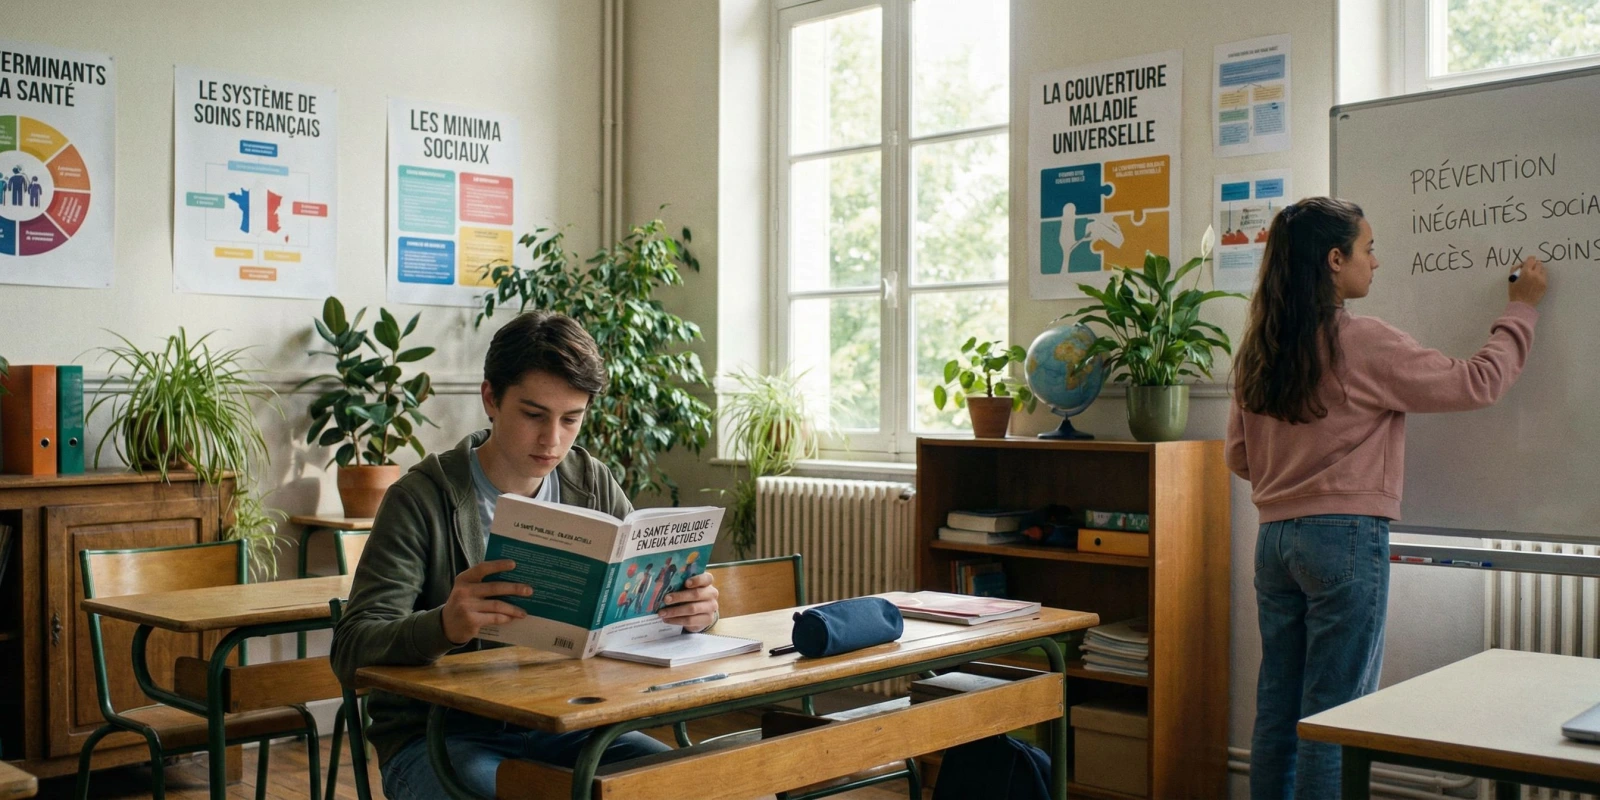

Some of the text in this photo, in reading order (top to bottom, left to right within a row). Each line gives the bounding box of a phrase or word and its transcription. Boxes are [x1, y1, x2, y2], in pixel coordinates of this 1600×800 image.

[0, 51, 106, 85] ERMINANTS
[1043, 64, 1167, 105] LA COUVERTURE
[17, 79, 75, 107] SANTÉ
[199, 80, 317, 114] LE SYSTÈME DE
[194, 103, 321, 138] SOINS FRANÇAIS
[410, 109, 501, 142] LES MINIMA
[1069, 96, 1138, 127] MALADIE
[423, 136, 489, 165] SOCIAUX
[1053, 120, 1156, 155] UNIVERSELLE
[1411, 243, 1474, 276] ACCÈS
[1485, 246, 1524, 268] AUX
[631, 529, 641, 541] LA
[643, 522, 671, 538] SANTÉ
[671, 518, 711, 534] PUBLIQUE
[636, 537, 668, 551] ENJEUX
[668, 531, 704, 546] ACTUELS
